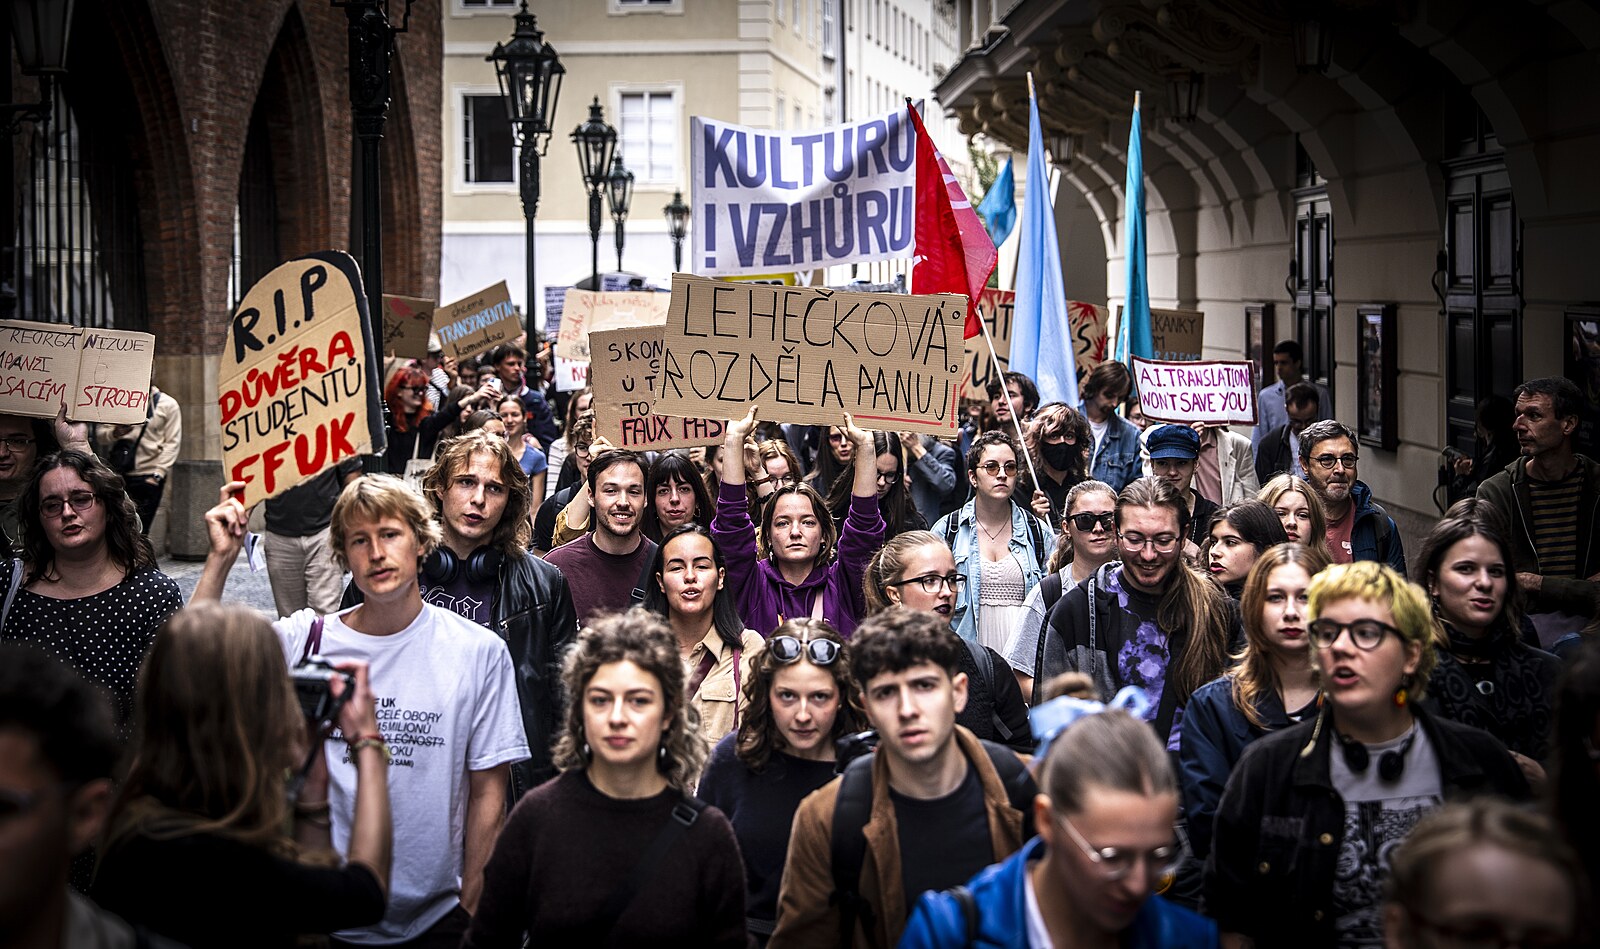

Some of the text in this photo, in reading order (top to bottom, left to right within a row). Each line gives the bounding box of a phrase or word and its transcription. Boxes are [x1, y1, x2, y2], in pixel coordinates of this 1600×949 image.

[704, 111, 915, 190] KULTURU
[728, 183, 913, 267] VZHŮRU
[233, 265, 328, 364] R.I.P
[10, 329, 149, 352] REORGANIZUJE
[78, 385, 150, 412] STROJEM
[219, 331, 355, 426] DŮVĚRA
[661, 345, 815, 406] ROZDĚL
[821, 360, 845, 408] A
[1164, 367, 1250, 388] TRANSLATION
[223, 357, 362, 452] STUDENTŮ
[1141, 391, 1248, 413] WON'T SAVE YOU
[621, 415, 673, 446] FAUX
[231, 412, 357, 505] FFUK
[402, 709, 443, 723] OBORY
[387, 745, 414, 757] OKU
